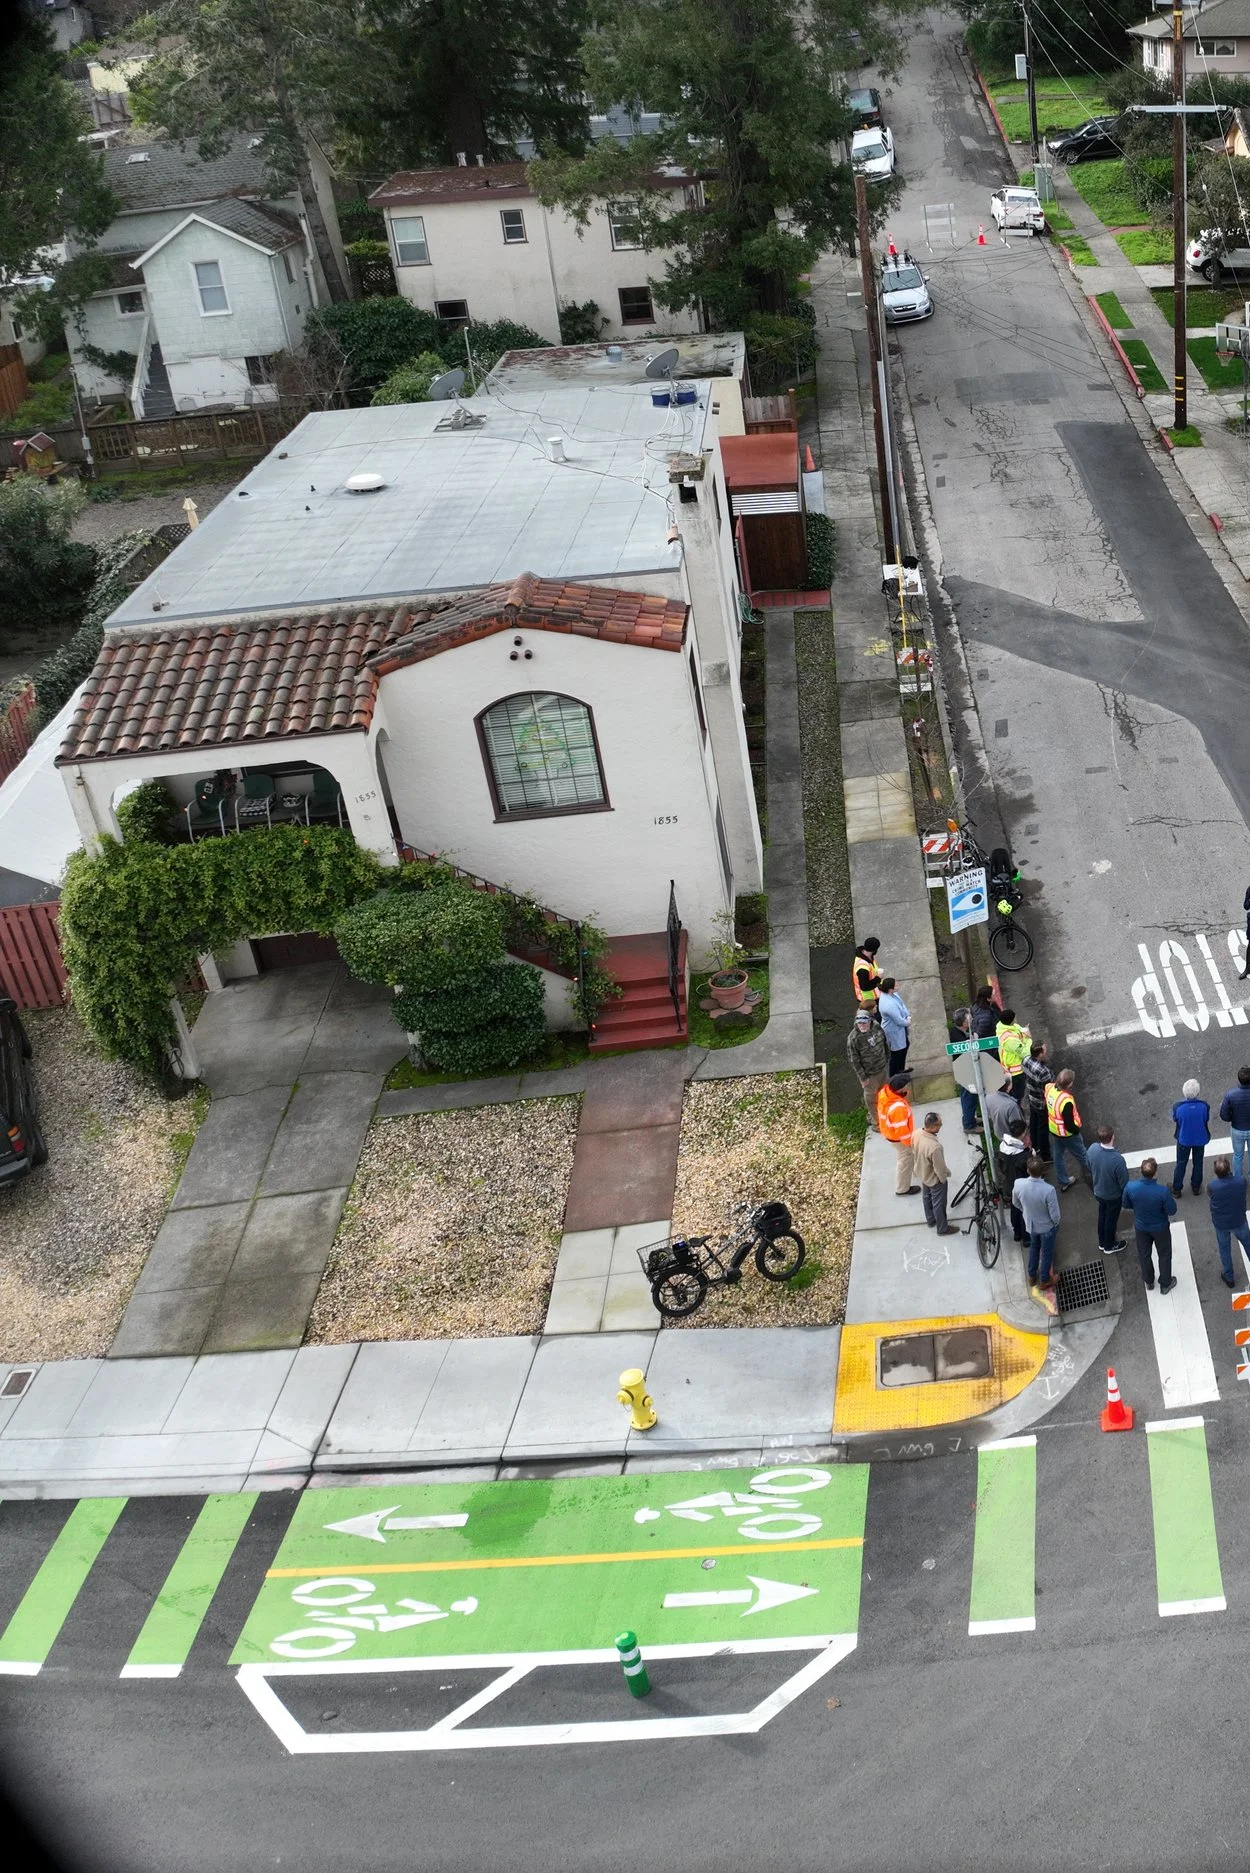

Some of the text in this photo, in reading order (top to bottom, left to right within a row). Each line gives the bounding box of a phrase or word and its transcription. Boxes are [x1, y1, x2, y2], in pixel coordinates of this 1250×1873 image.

[355, 790, 376, 804] 1855
[654, 815, 678, 825] 1855
[949, 870, 983, 887] WARNING
